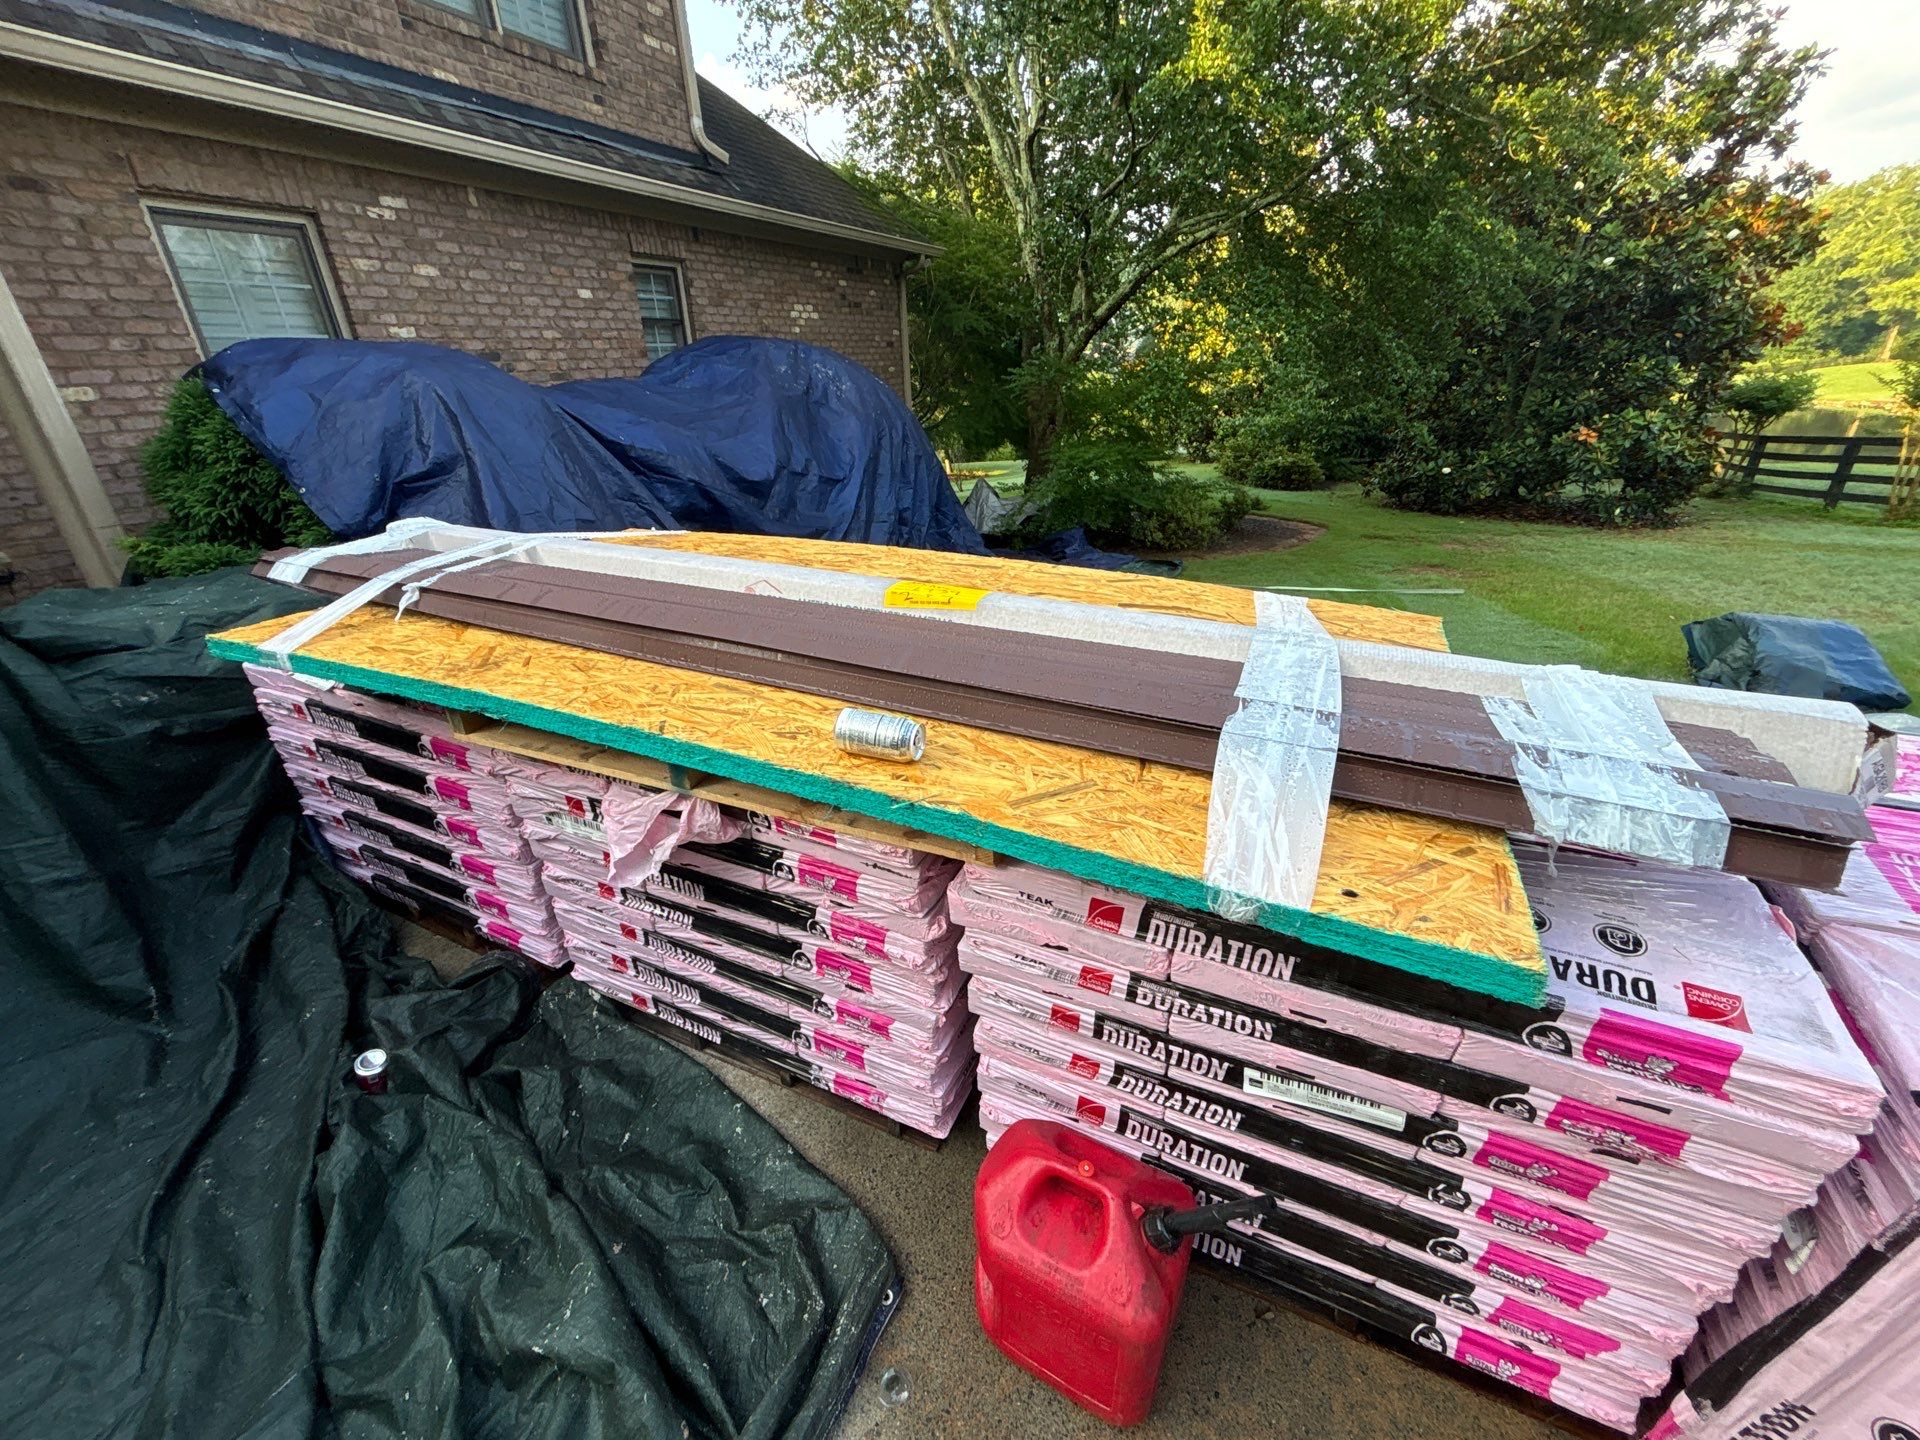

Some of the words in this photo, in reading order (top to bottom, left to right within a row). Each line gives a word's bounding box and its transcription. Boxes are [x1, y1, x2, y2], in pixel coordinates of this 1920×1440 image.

[646, 872, 705, 901] RATION
[1018, 890, 1054, 907] TEAK
[1145, 917, 1296, 982] DURATION
[637, 965, 701, 1005] DURATION
[1549, 954, 1658, 1006] DURA
[1686, 986, 1741, 1008] CORNING
[1135, 987, 1274, 1041] DURATION
[1688, 993, 1732, 1011] OWENS
[657, 1007, 722, 1045] DURATION
[1102, 1026, 1230, 1081] DURATION
[1116, 1074, 1243, 1131] DURATION
[1124, 1119, 1245, 1181] DURATION
[1191, 1231, 1242, 1267] TION
[1730, 1399, 1818, 1440] TION
